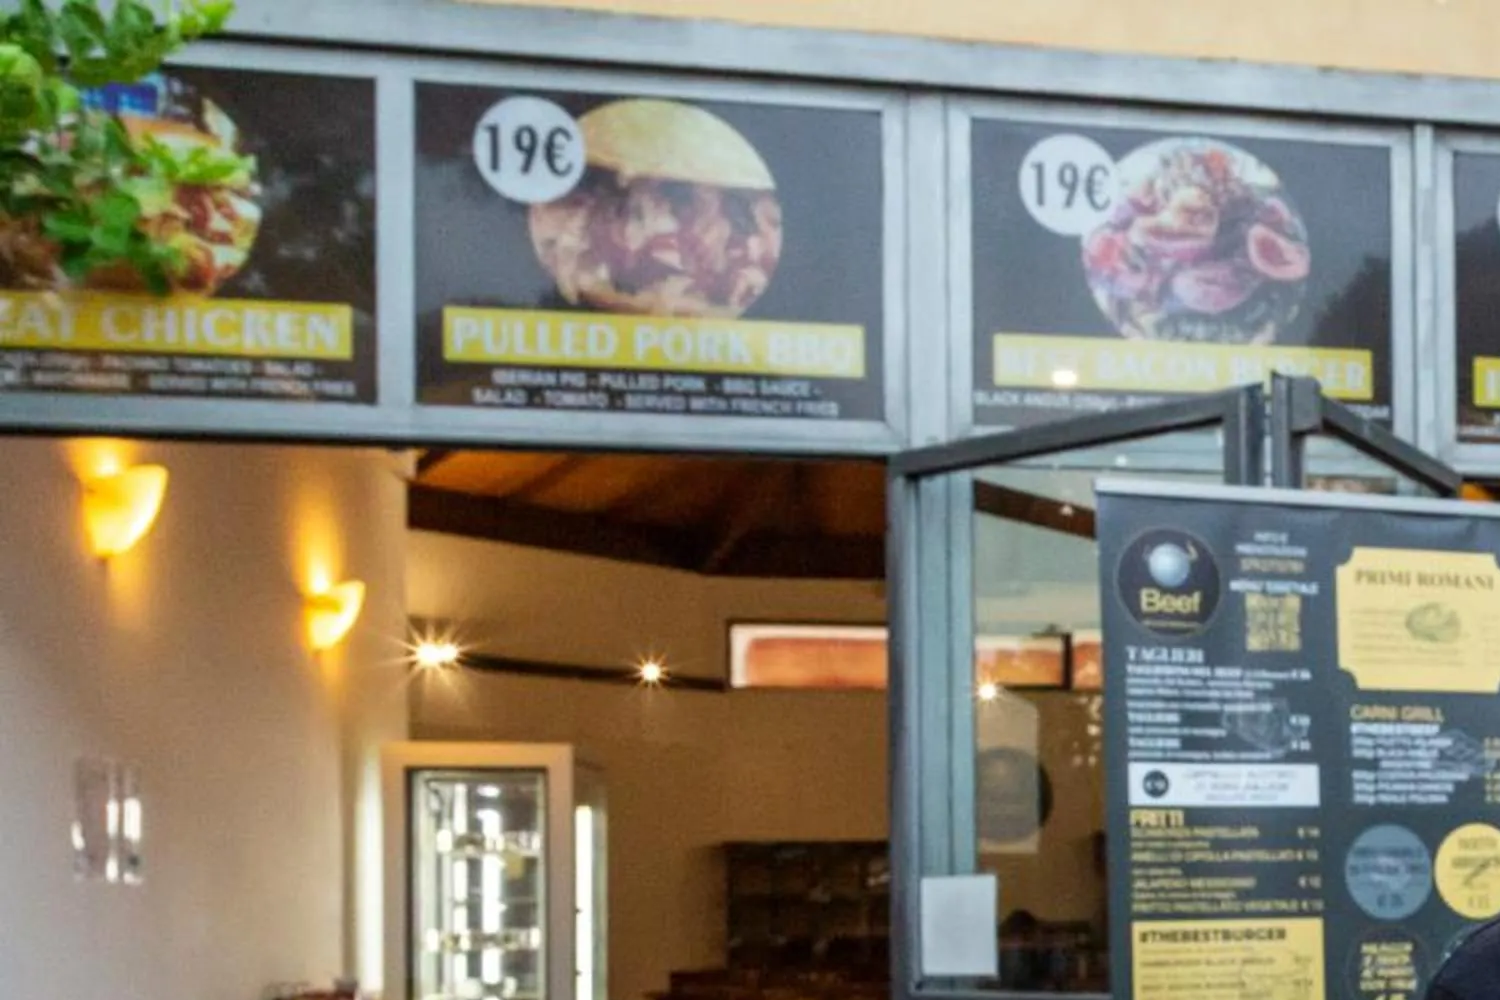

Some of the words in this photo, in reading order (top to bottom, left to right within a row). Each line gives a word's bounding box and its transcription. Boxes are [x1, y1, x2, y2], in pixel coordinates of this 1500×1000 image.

[482, 122, 575, 178] 19€
[1030, 158, 1111, 212] 19€
[101, 304, 340, 351] CHICKEN
[451, 315, 618, 359] PULLED
[633, 323, 753, 364] PORK
[766, 333, 852, 370] BBQ
[1096, 350, 1217, 384] BACON
[1140, 587, 1201, 614] Beef
[1354, 568, 1412, 586] PRIMI
[1416, 572, 1495, 591] ROMANI
